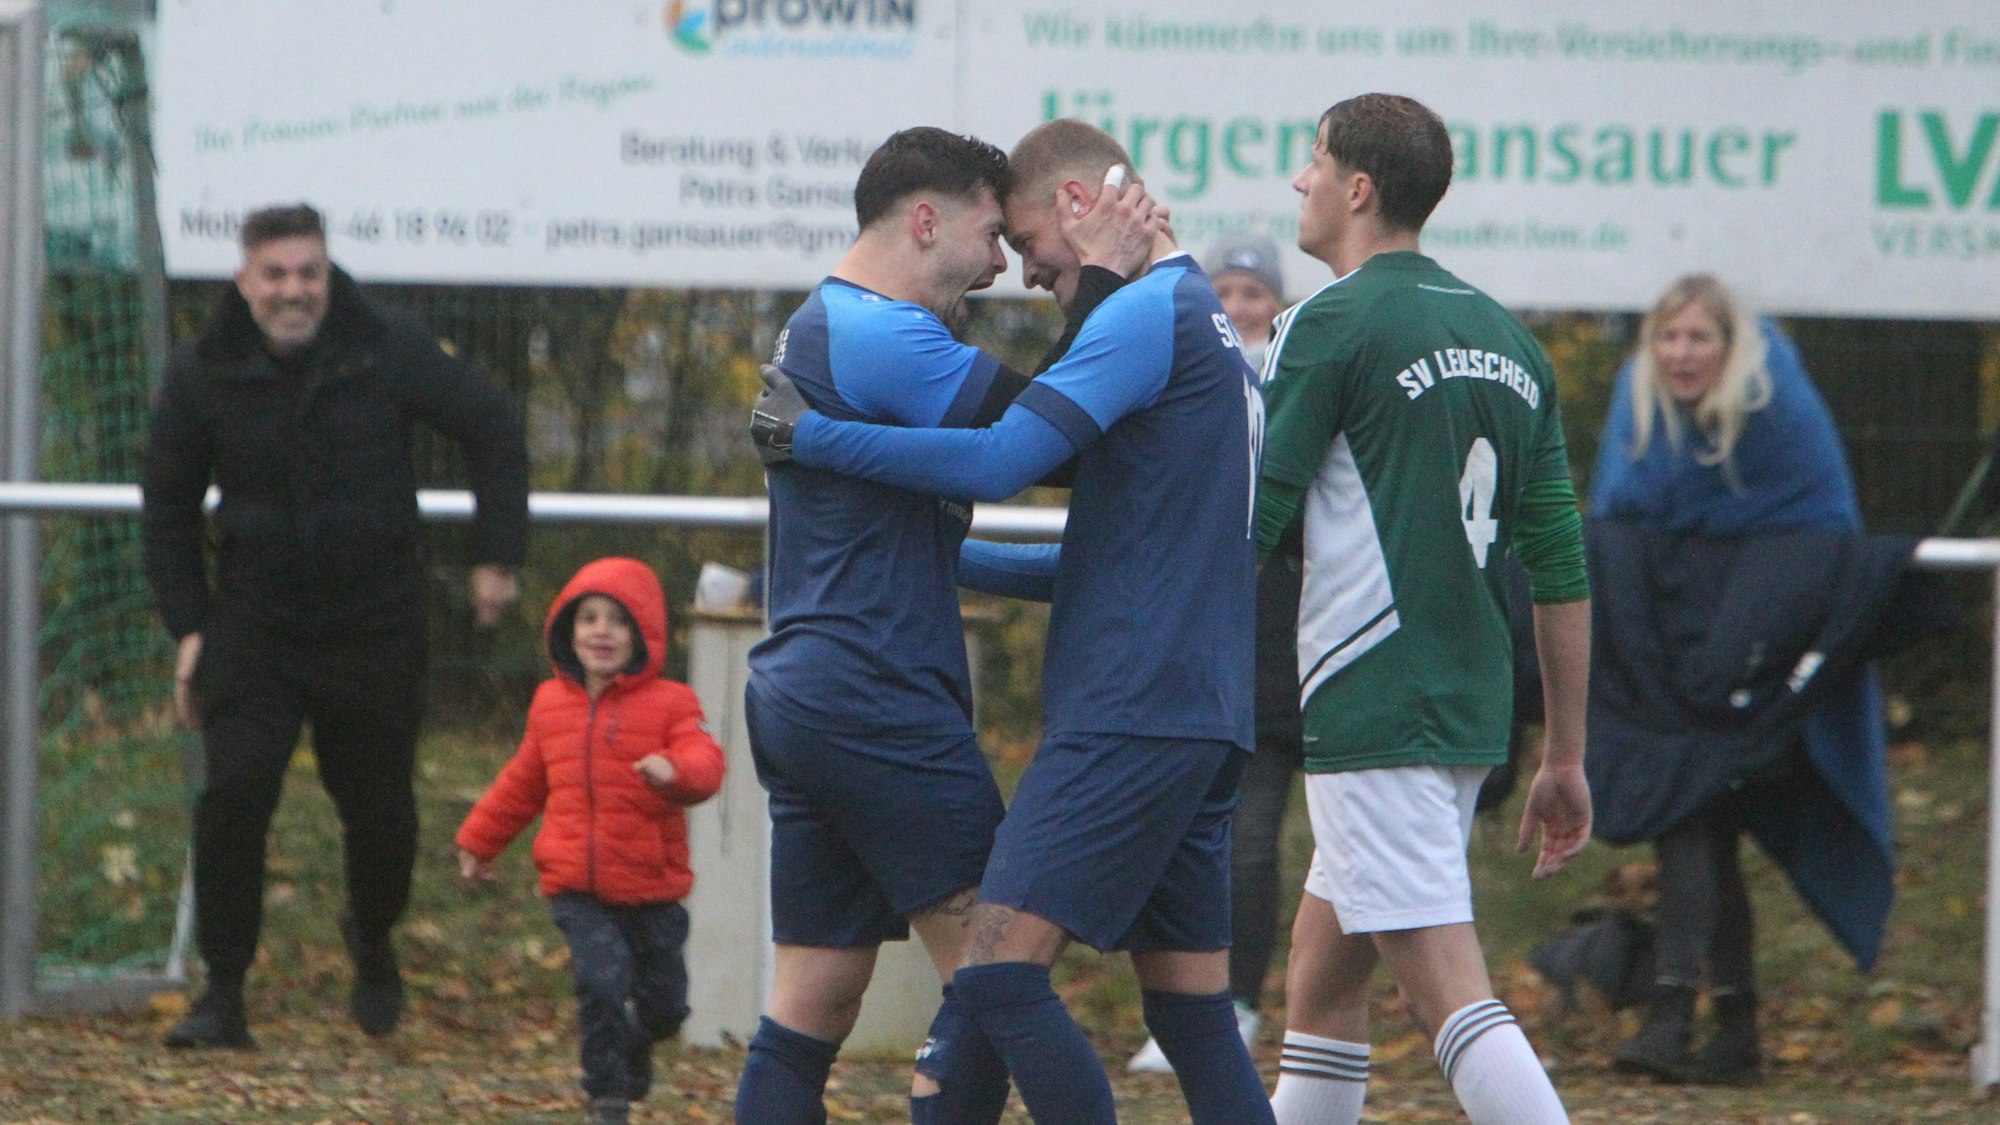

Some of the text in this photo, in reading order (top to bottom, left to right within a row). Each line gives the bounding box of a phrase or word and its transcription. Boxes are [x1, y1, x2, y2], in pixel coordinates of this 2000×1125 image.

[1022, 12, 1090, 48] Wir
[1316, 27, 1383, 55] uns
[1396, 28, 1457, 56] um
[1853, 27, 1930, 66] und
[620, 129, 868, 172] Beratung & Verk
[1040, 90, 1796, 201] rgen ansauer
[1876, 110, 2000, 208] LV
[680, 174, 856, 208] Petra Gansa
[180, 207, 243, 239] Mob
[1396, 358, 1435, 400] SV
[1459, 436, 1498, 569] 4
